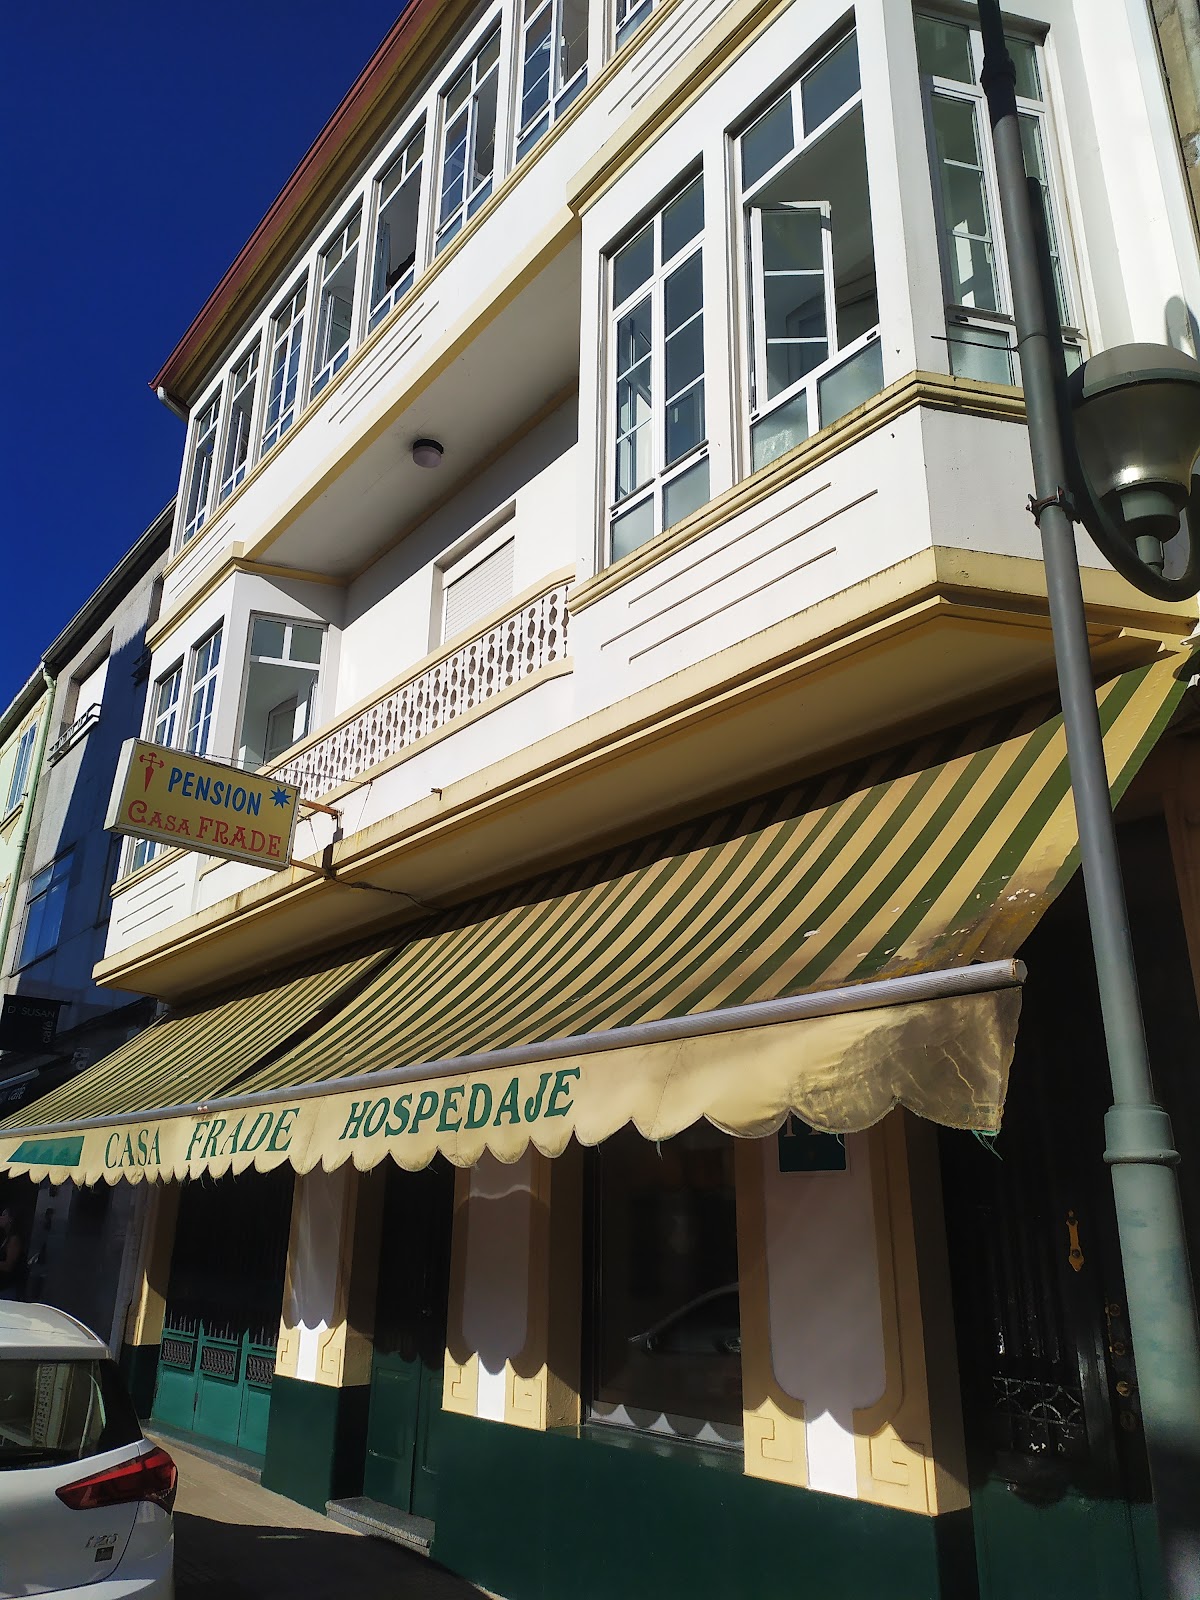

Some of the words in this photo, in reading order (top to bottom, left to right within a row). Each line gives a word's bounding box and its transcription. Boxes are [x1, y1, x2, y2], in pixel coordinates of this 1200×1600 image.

[168, 767, 262, 816] PENSION
[196, 815, 282, 858] FRADE
[105, 1127, 162, 1168] CASA
[185, 1107, 301, 1160] FRADE
[338, 1067, 581, 1141] HOSPEDAJE
